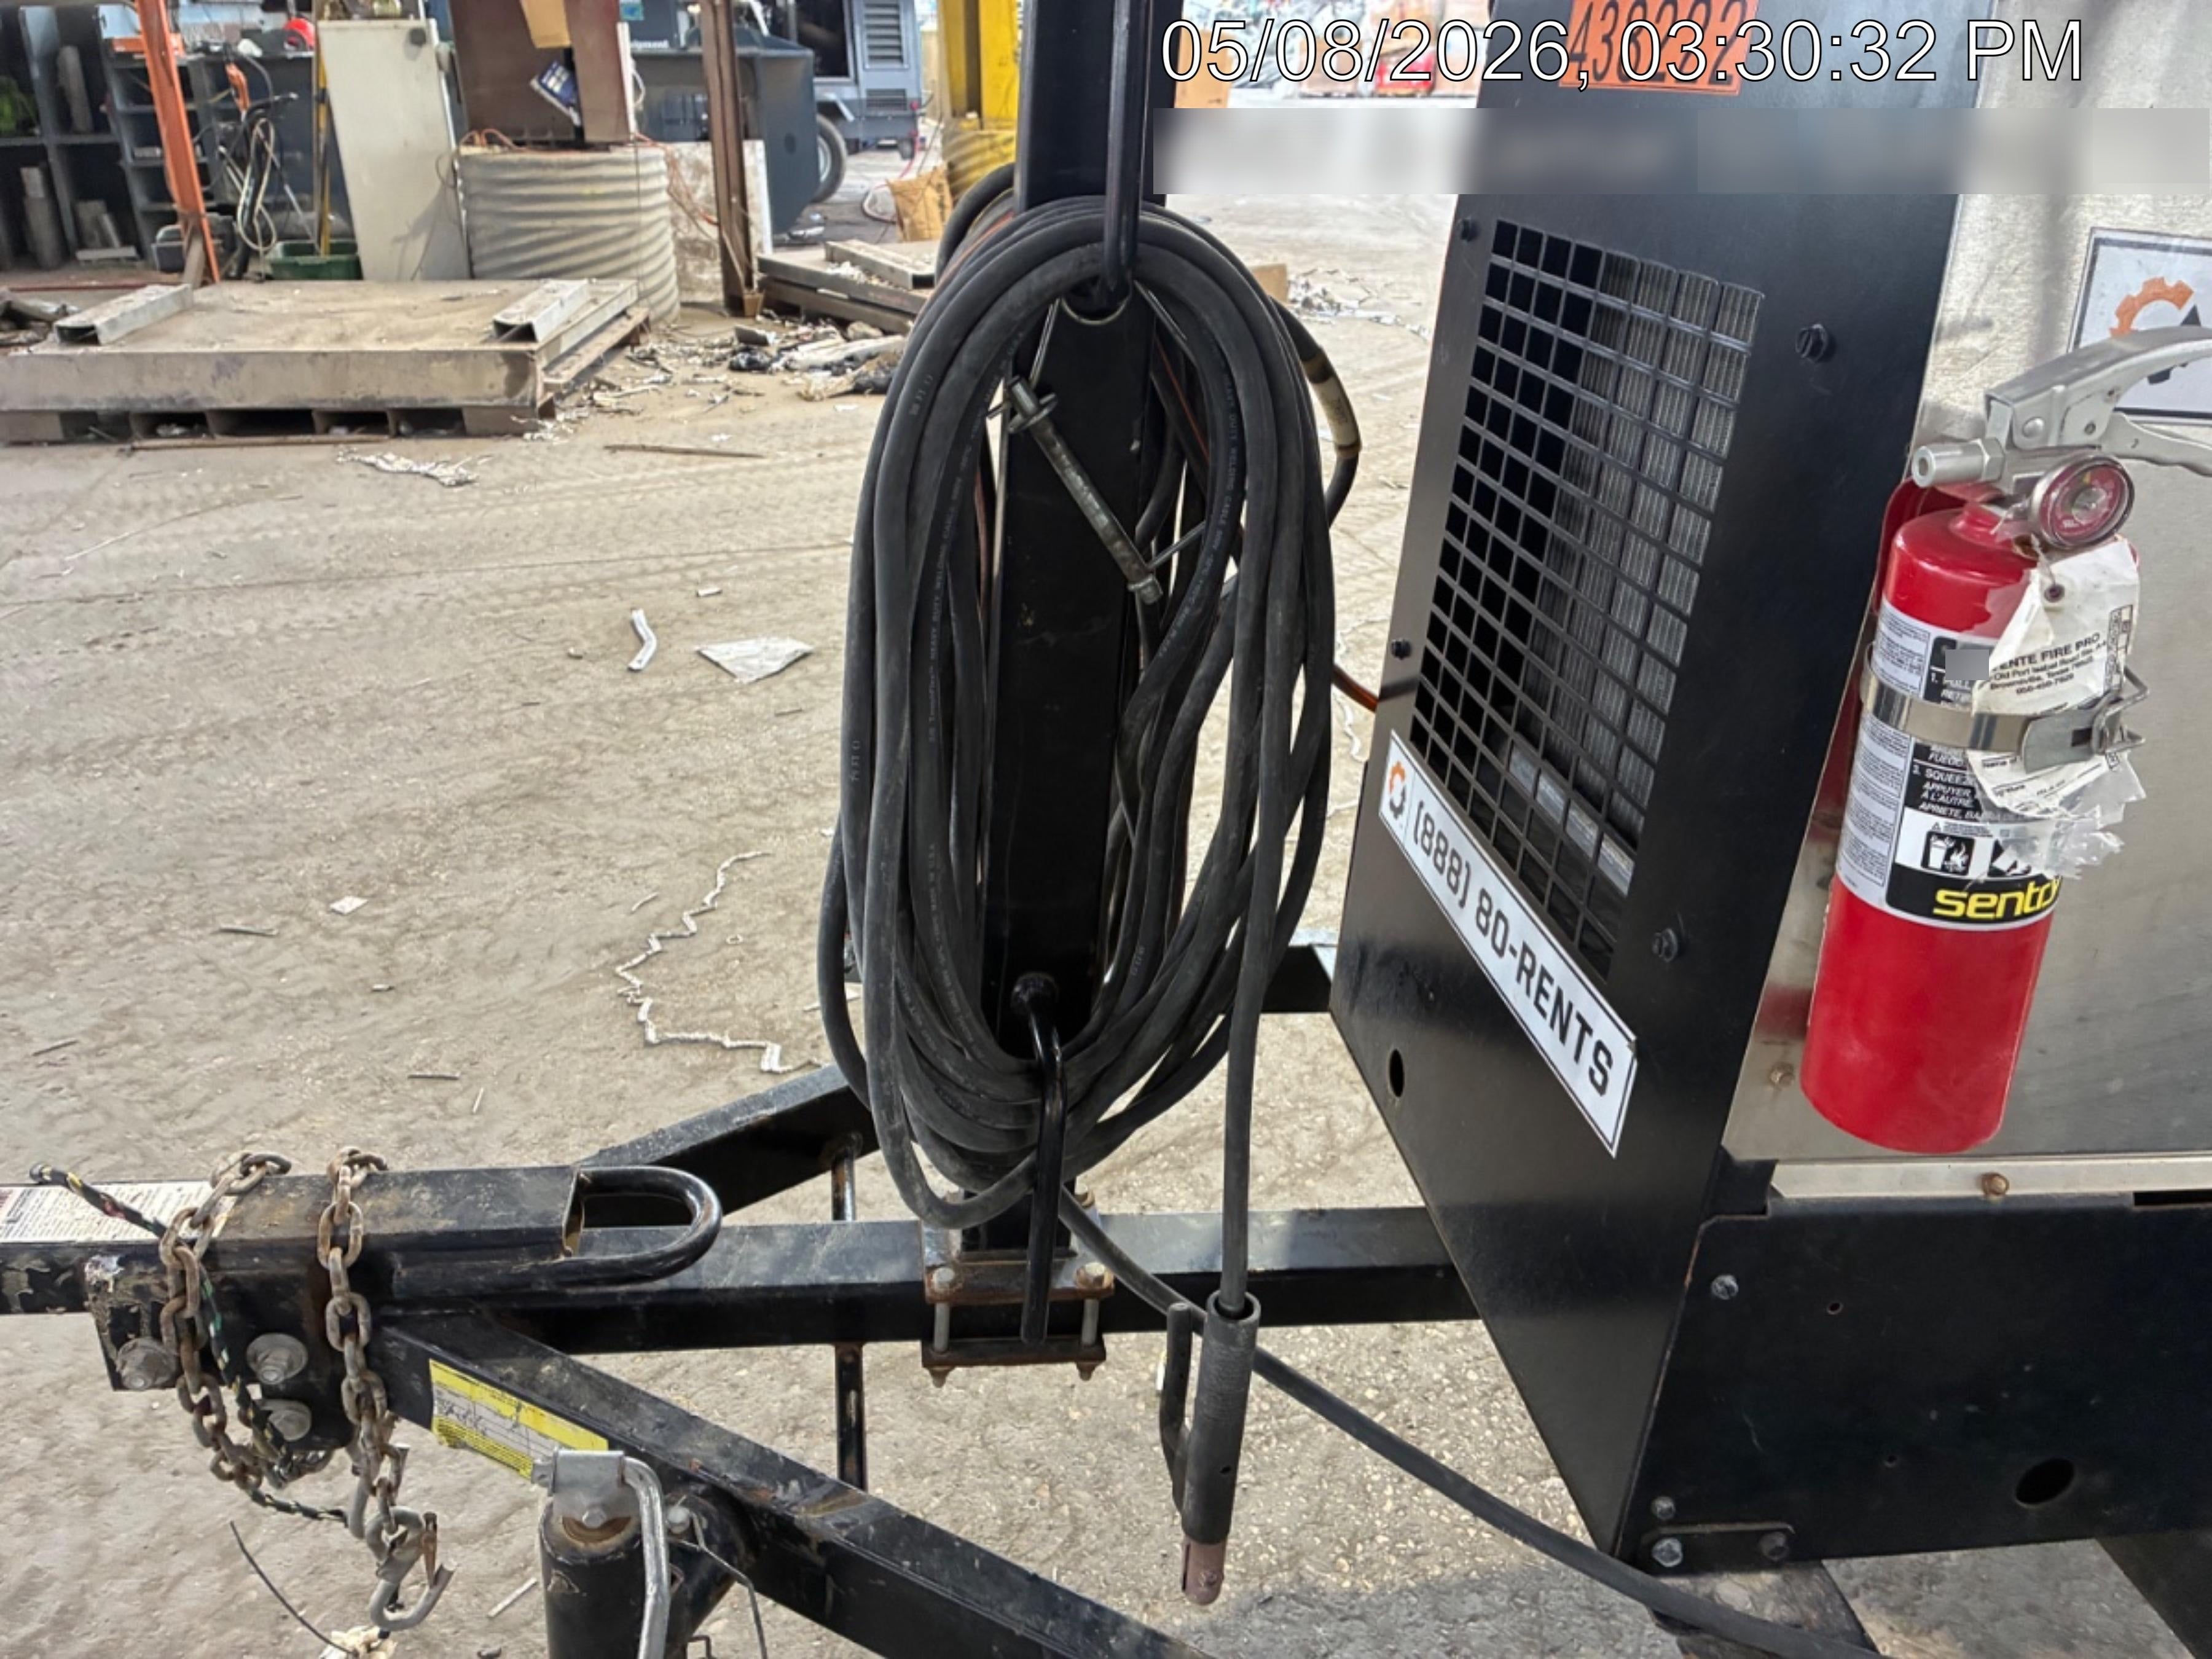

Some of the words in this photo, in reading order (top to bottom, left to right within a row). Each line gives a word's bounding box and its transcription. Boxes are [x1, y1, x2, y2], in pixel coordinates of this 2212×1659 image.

[2040, 643, 2073, 662] FIRE
[2075, 632, 2100, 651] PRO
[1414, 800, 1470, 909] (888)
[1475, 888, 1614, 1097] 80-RENTS
